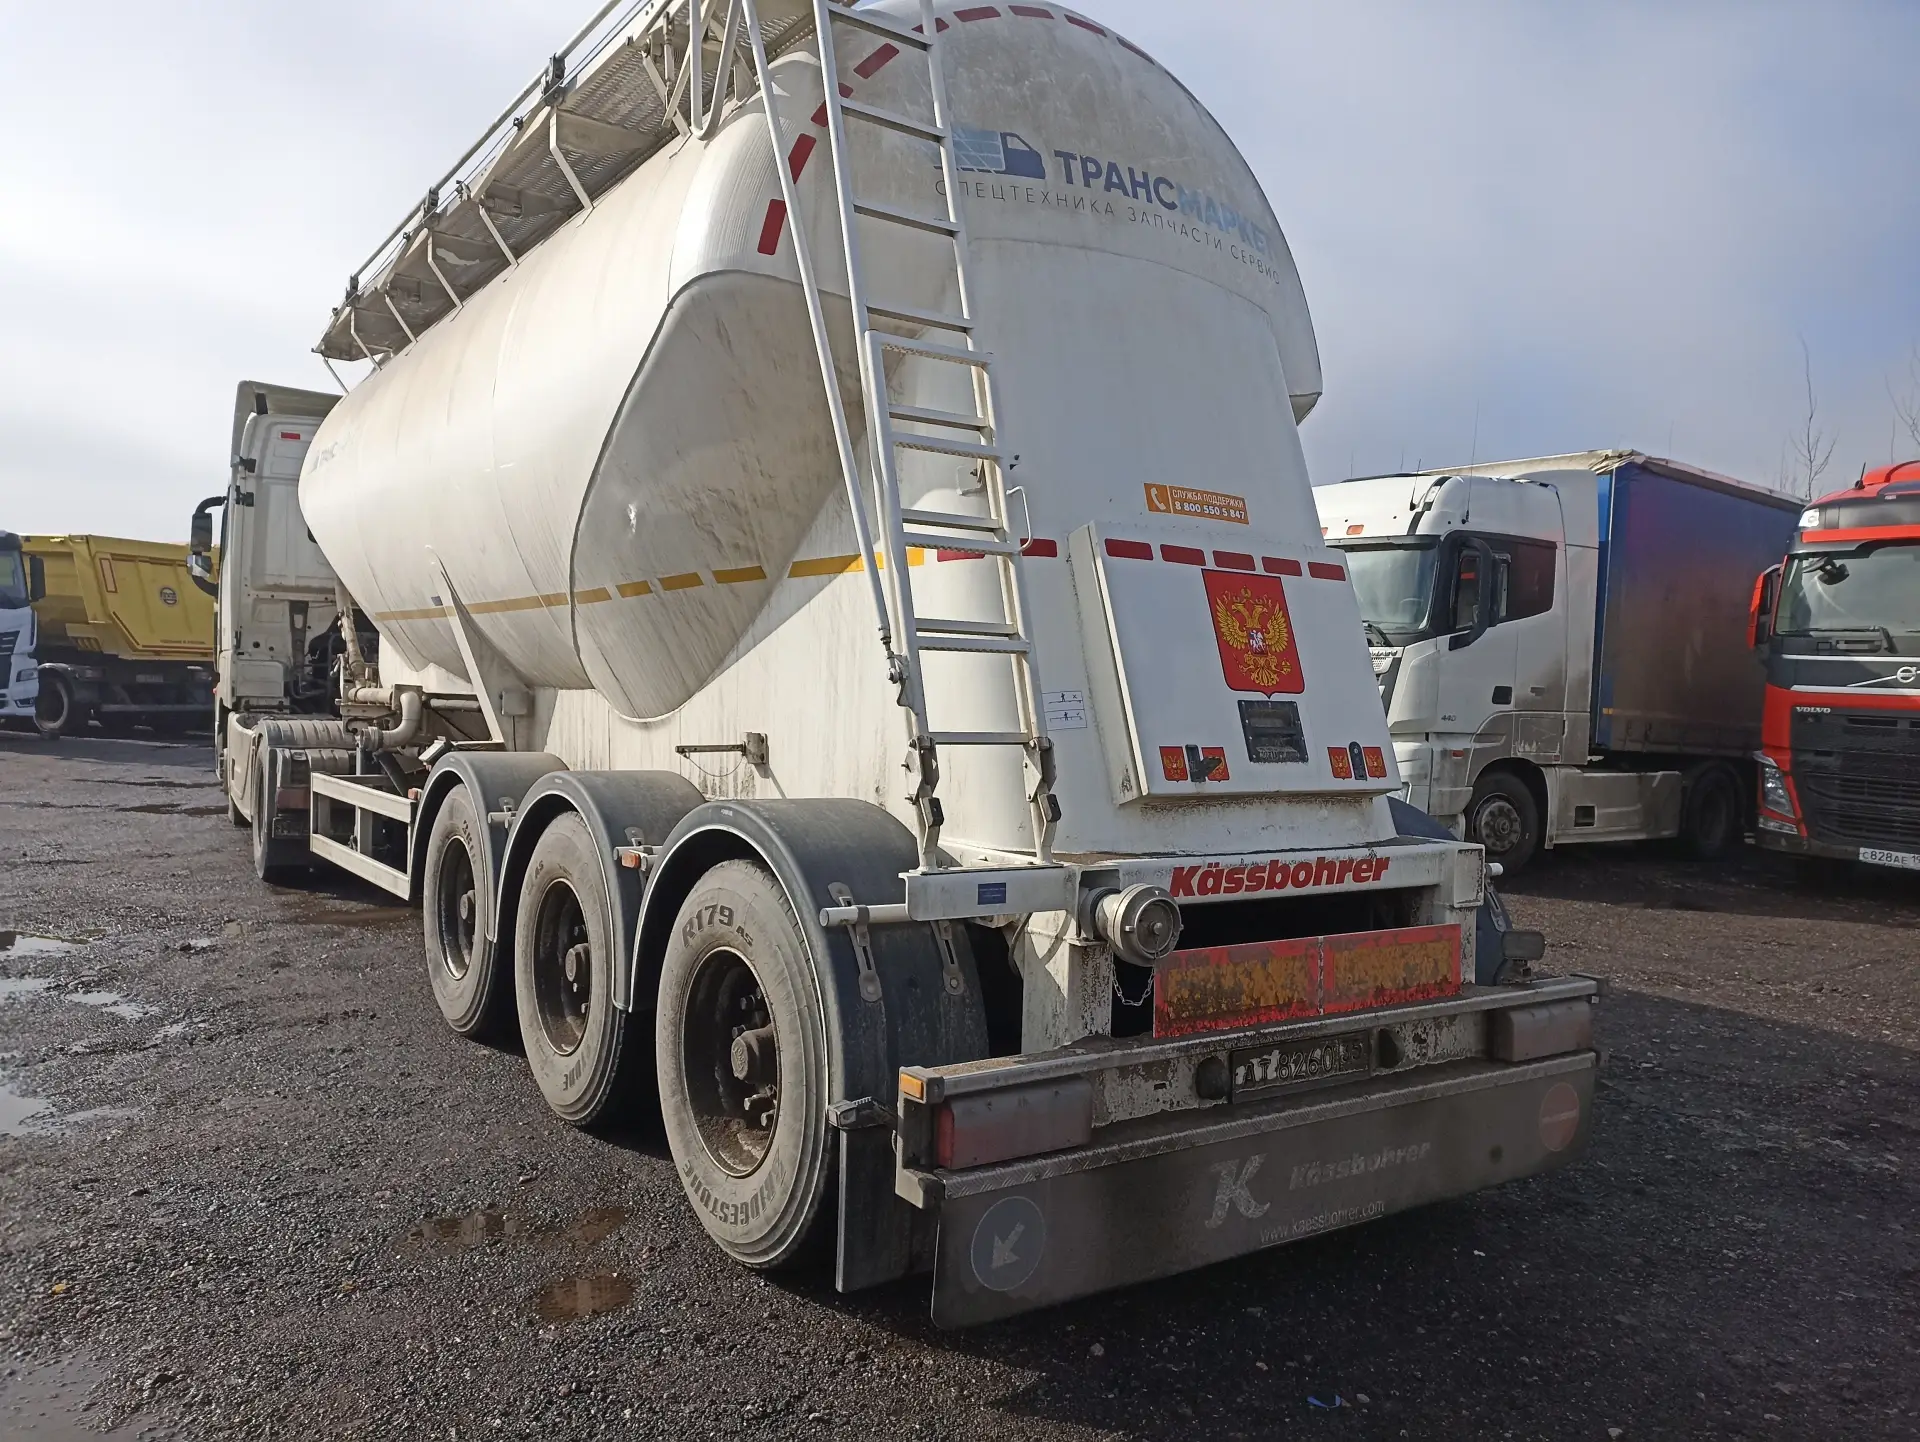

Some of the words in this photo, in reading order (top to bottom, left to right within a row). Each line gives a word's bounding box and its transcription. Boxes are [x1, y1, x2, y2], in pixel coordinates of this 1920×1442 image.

[935, 180, 1115, 216] СПЕЦТЕХНИКА
[1127, 206, 1222, 251] ЗАПЧАСТИ
[1230, 245, 1280, 284] СЕРВИС
[1172, 489, 1203, 501] СЛУЖБА
[1203, 493, 1244, 509] ПОДДЕРЖКИ
[1796, 706, 1831, 714] VOLVO
[1169, 856, 1390, 897] Kässbohrer
[682, 904, 734, 948] R179
[736, 925, 754, 947] AS
[1288, 1141, 1431, 1191] Kässbohrer
